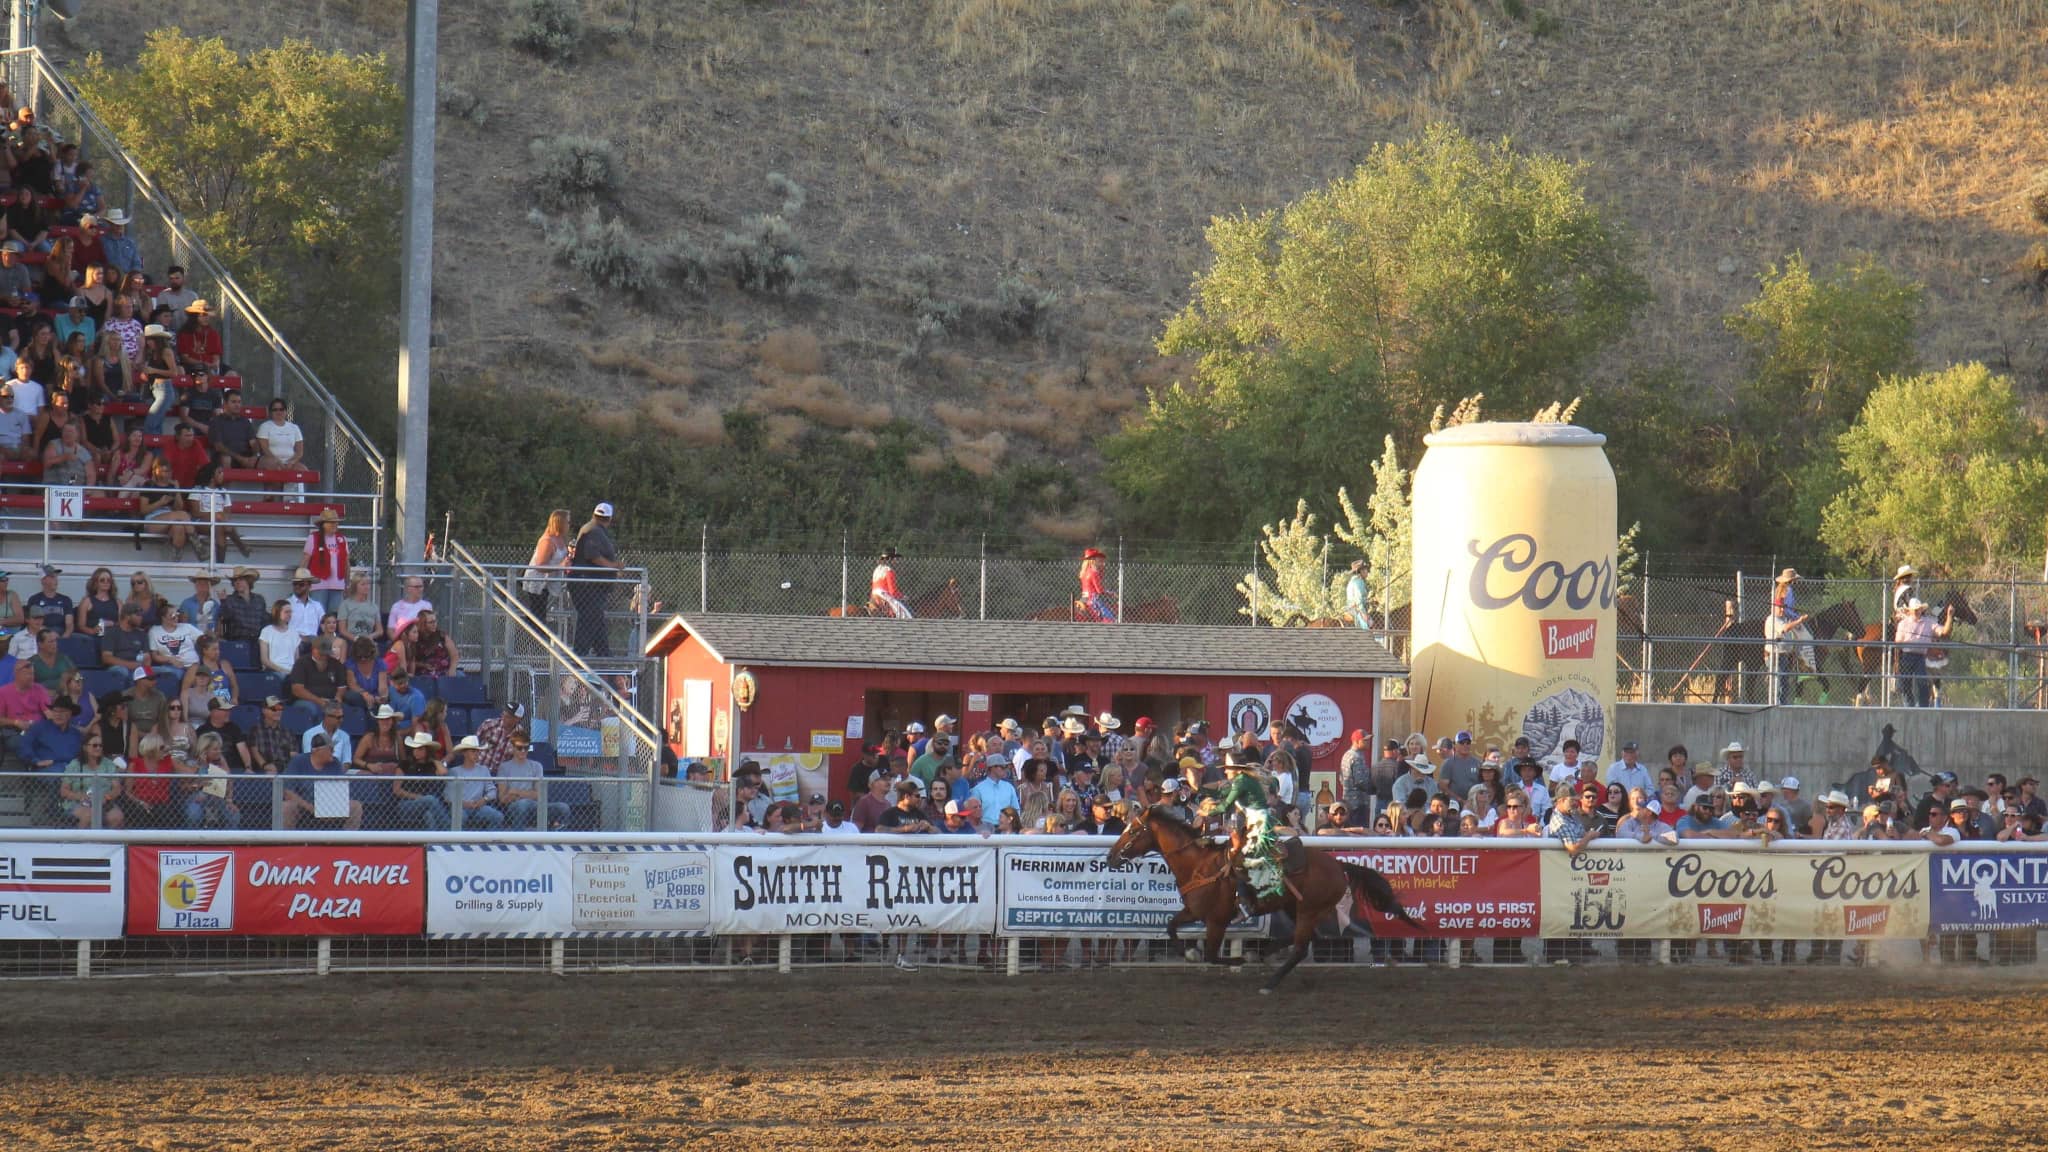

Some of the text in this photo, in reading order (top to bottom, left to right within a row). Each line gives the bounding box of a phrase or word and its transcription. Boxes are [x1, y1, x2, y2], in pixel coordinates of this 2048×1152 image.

[54, 490, 79, 498] Section
[61, 498, 73, 517] K
[1468, 533, 1617, 611] Coor
[1548, 623, 1595, 656] Banquet
[163, 855, 198, 866] Travel
[1011, 858, 1085, 873] HERRIMAN
[1569, 852, 1626, 871] Coors
[249, 860, 410, 887] OMAK TRAVEL
[584, 863, 630, 876] Drilling
[1665, 853, 1777, 898] Coors
[1810, 855, 1920, 900] Coors
[1941, 857, 2048, 885] MONT
[445, 873, 553, 894] O'Connell
[589, 879, 626, 890] Pumps
[644, 866, 704, 890] WELCOME
[733, 854, 979, 911] SMITH RANCH
[1043, 878, 1178, 892] Commercial or Resi
[1413, 876, 1458, 889] market
[666, 882, 705, 898] RODEO
[2002, 892, 2048, 904] SILVE
[288, 893, 362, 919] PLAZA
[455, 898, 544, 912] Drilling & Supply
[576, 893, 637, 904] Electrical
[1017, 893, 1053, 902] Licensed
[1055, 894, 1062, 902] &
[1063, 894, 1094, 903] Bonded
[1105, 894, 1137, 905] Serving
[1137, 895, 1177, 905] Okanogan
[0, 904, 57, 921] FUEL
[579, 908, 635, 919] Irrigation
[1434, 902, 1536, 915] SHOP US FIRST,
[174, 911, 220, 928] Plaza
[786, 913, 927, 928] MONSE, WA.
[1015, 911, 1174, 925] SEPTIC TANK CLEANING
[1439, 917, 1532, 929] SAVE 40-60%
[1703, 908, 1742, 932] Banquet
[1848, 908, 1886, 932] Banquet
